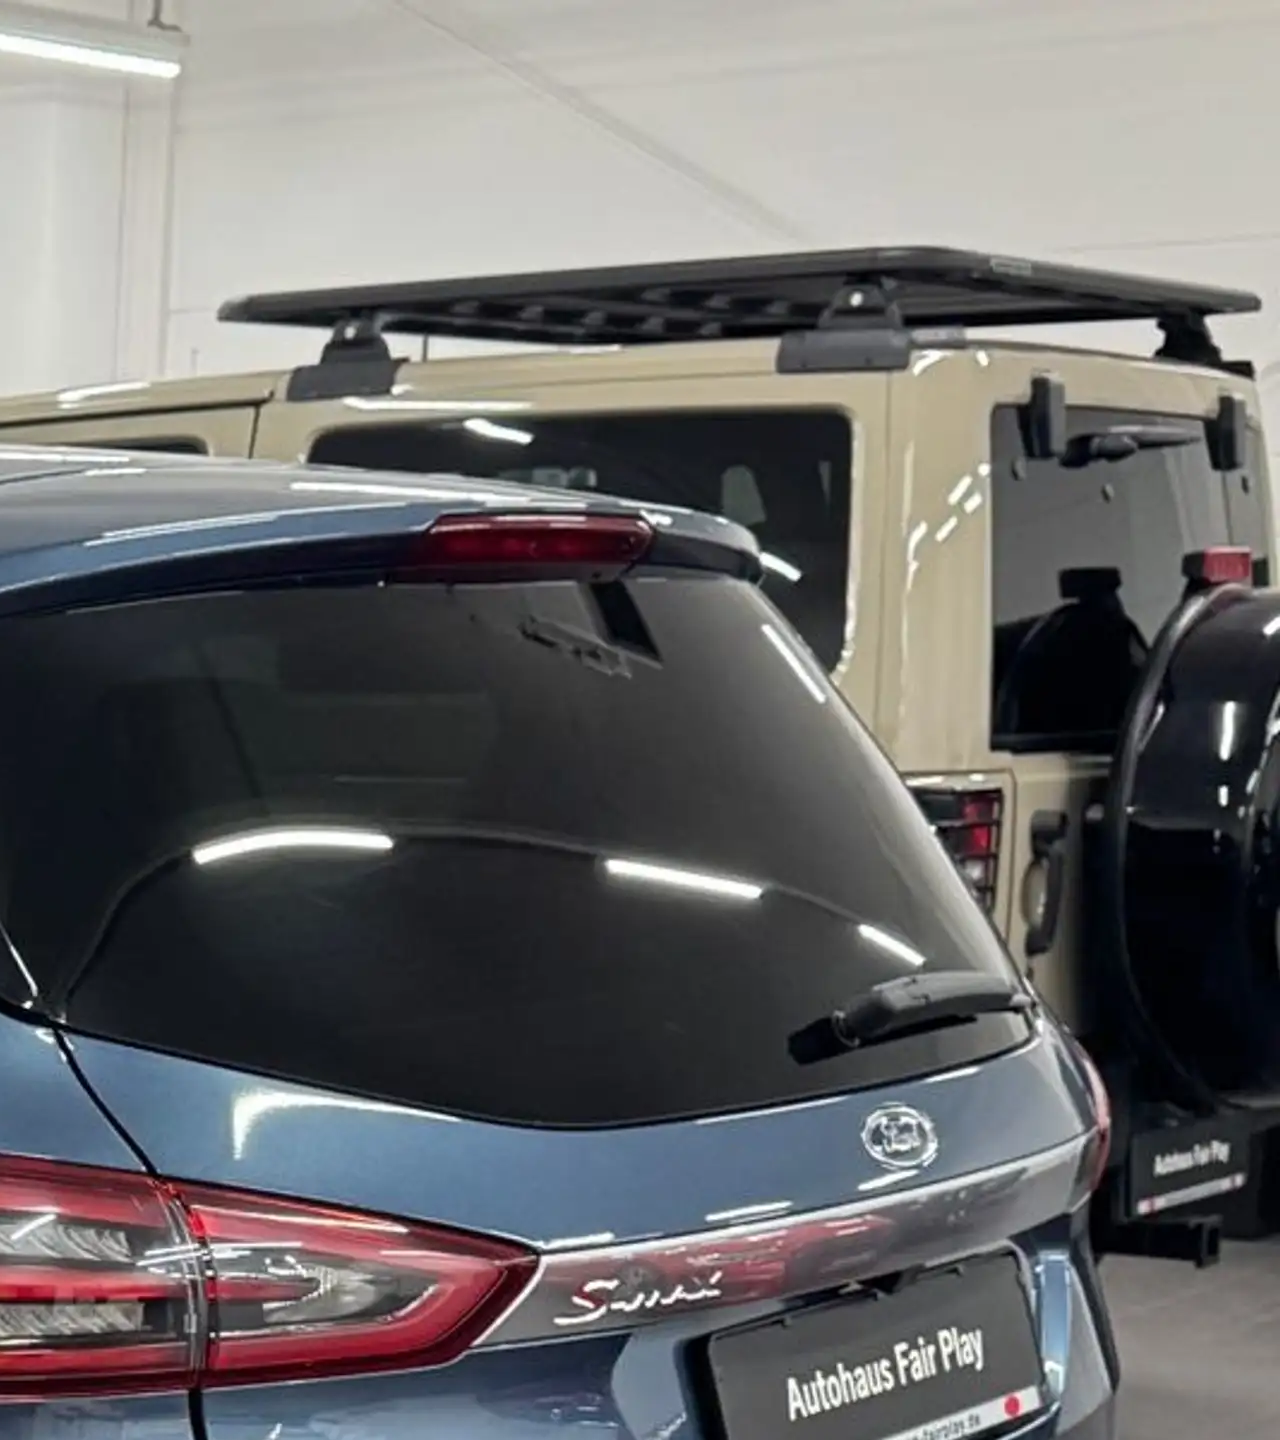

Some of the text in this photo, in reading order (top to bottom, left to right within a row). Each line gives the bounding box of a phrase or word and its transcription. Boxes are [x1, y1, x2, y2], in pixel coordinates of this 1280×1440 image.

[787, 1326, 984, 1422] Autohaus Fair Play
